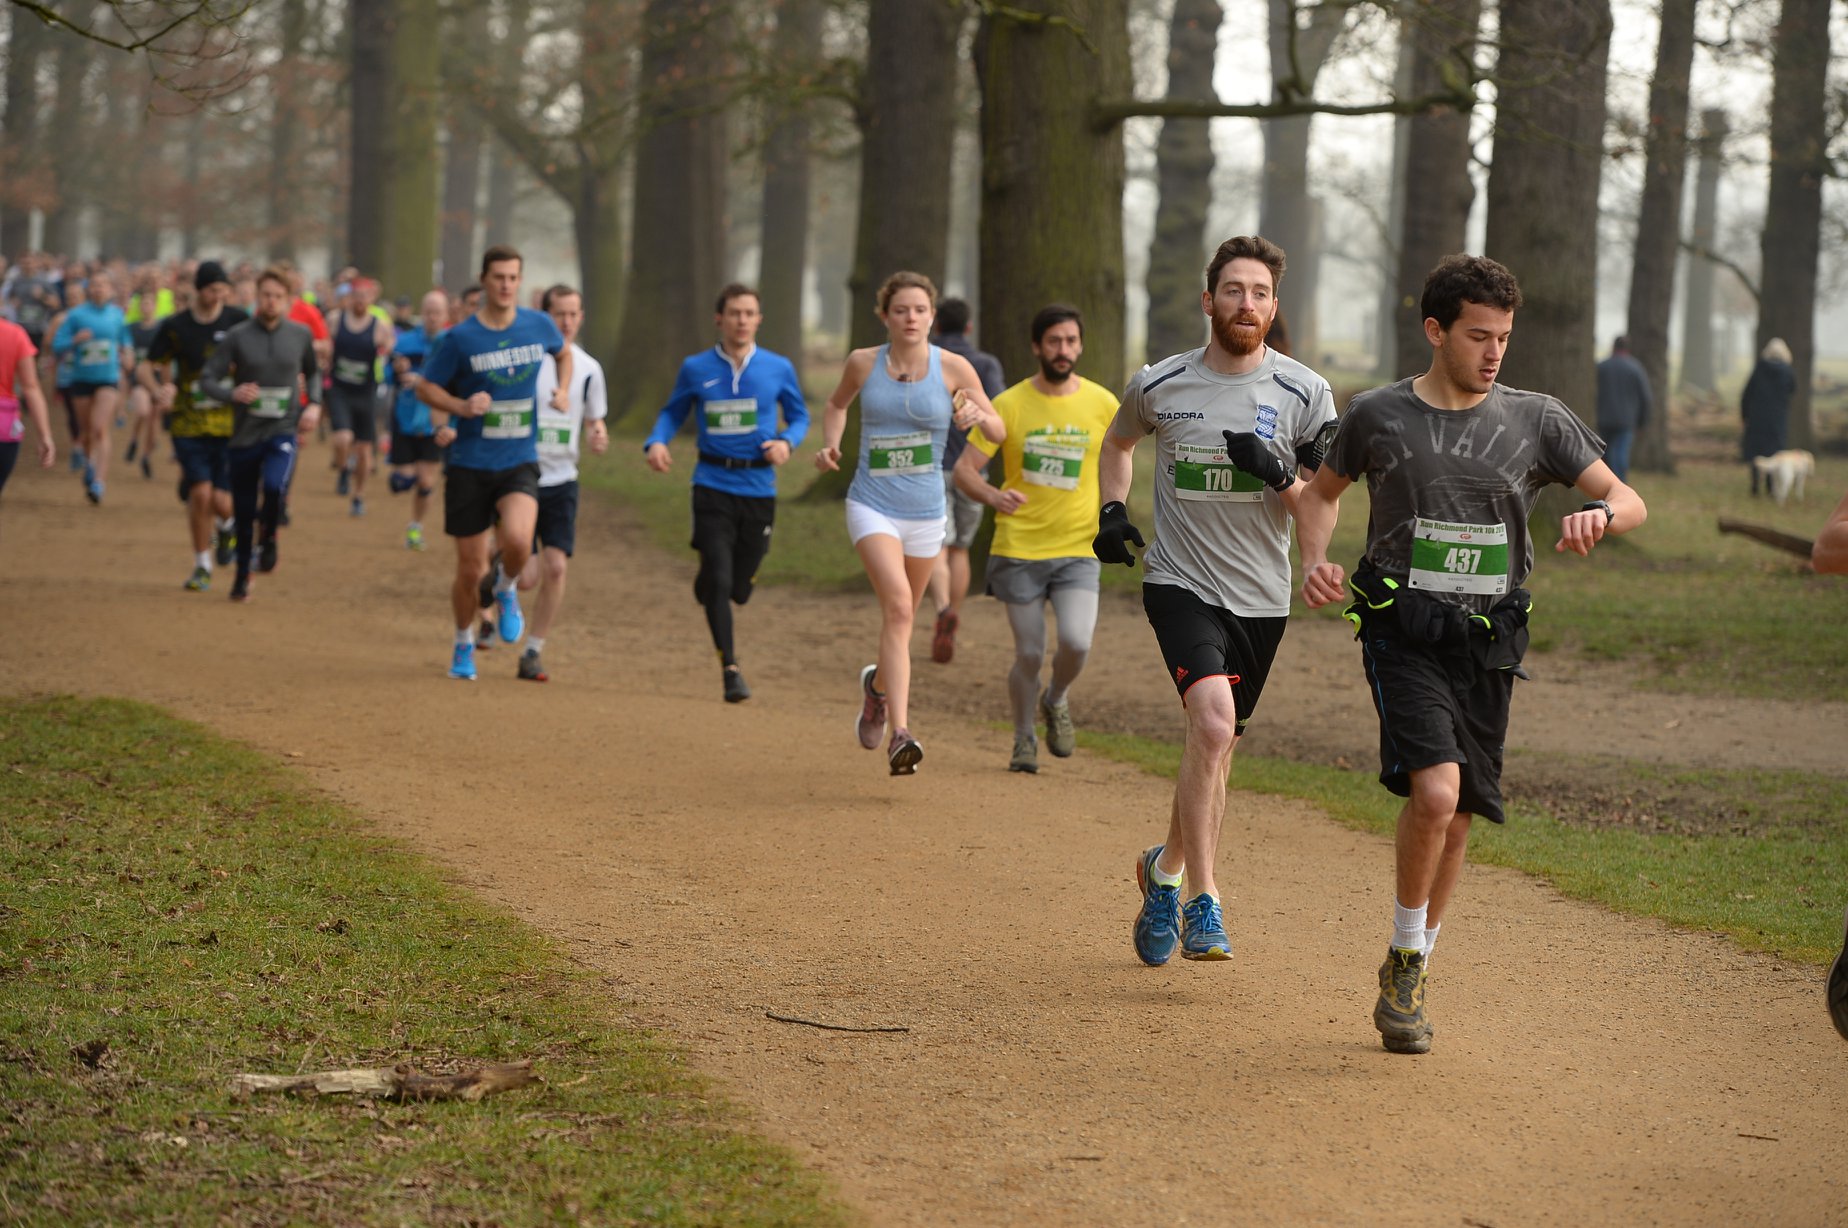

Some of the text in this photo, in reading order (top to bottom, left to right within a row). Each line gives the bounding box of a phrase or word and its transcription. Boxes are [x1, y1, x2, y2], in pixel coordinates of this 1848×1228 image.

[1157, 412, 1204, 420] DIADORA
[1179, 445, 1189, 453] Run
[1190, 446, 1220, 454] Richmond
[887, 449, 915, 468] 352
[1203, 468, 1233, 491] 170
[1420, 520, 1433, 529] Run
[1434, 522, 1467, 532] Richmond
[1469, 525, 1483, 534] Park
[1444, 547, 1481, 574] 437
